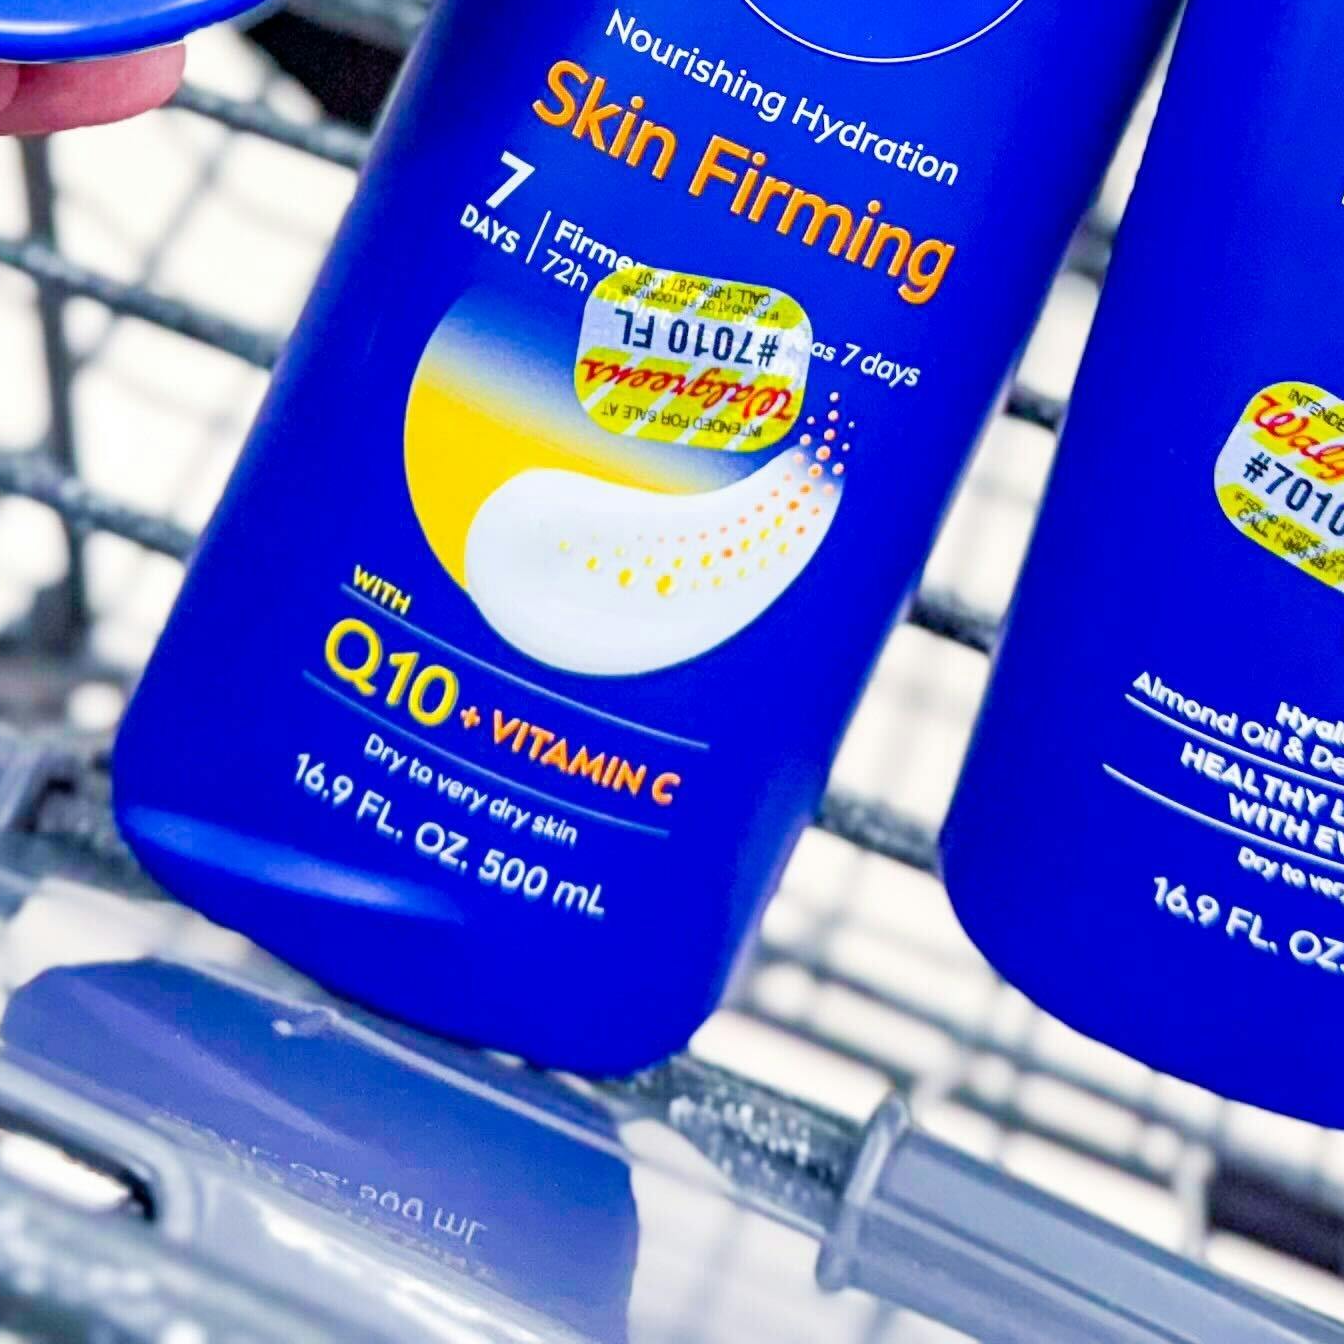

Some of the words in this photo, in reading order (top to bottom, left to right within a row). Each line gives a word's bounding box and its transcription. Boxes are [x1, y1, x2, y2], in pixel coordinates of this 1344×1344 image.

[605, 8, 788, 123] Nourishing
[792, 96, 960, 186] Hydration
[485, 150, 536, 209] 7
[531, 59, 677, 182] Skin
[687, 134, 955, 305] Firming
[460, 203, 521, 253] DAYS
[541, 248, 589, 292] 72h
[614, 308, 655, 349] FL
[668, 319, 779, 367] #7010
[580, 358, 793, 421] Walgreens
[811, 341, 836, 361] as
[844, 343, 864, 368] 7
[860, 352, 921, 388] days
[600, 403, 618, 416] AT
[623, 404, 656, 423] SALE
[661, 413, 689, 427] FOR
[693, 418, 762, 437] INTENDED
[1237, 508, 1270, 538] CALL
[353, 564, 411, 615] WITH
[324, 618, 459, 726] Q10
[492, 709, 647, 796] VITAMIN
[651, 771, 682, 806] C
[1132, 671, 1239, 740] Almond
[1241, 721, 1282, 753] Oil
[1283, 736, 1306, 764] &
[365, 733, 405, 772] Dry
[408, 756, 433, 784] to
[438, 771, 488, 814] very
[489, 796, 531, 832] dry
[532, 813, 578, 847] skin
[1180, 741, 1330, 816] HEALTHY
[295, 752, 355, 806] 16.9
[356, 789, 403, 839] FL.
[415, 821, 469, 870] OZ.
[478, 848, 548, 899] 500
[553, 880, 606, 917] mL
[1227, 792, 1311, 844] WITH
[1237, 845, 1280, 883] Dry
[1281, 861, 1307, 889] to
[1153, 875, 1221, 928] 16.9
[1224, 903, 1280, 955] FL.
